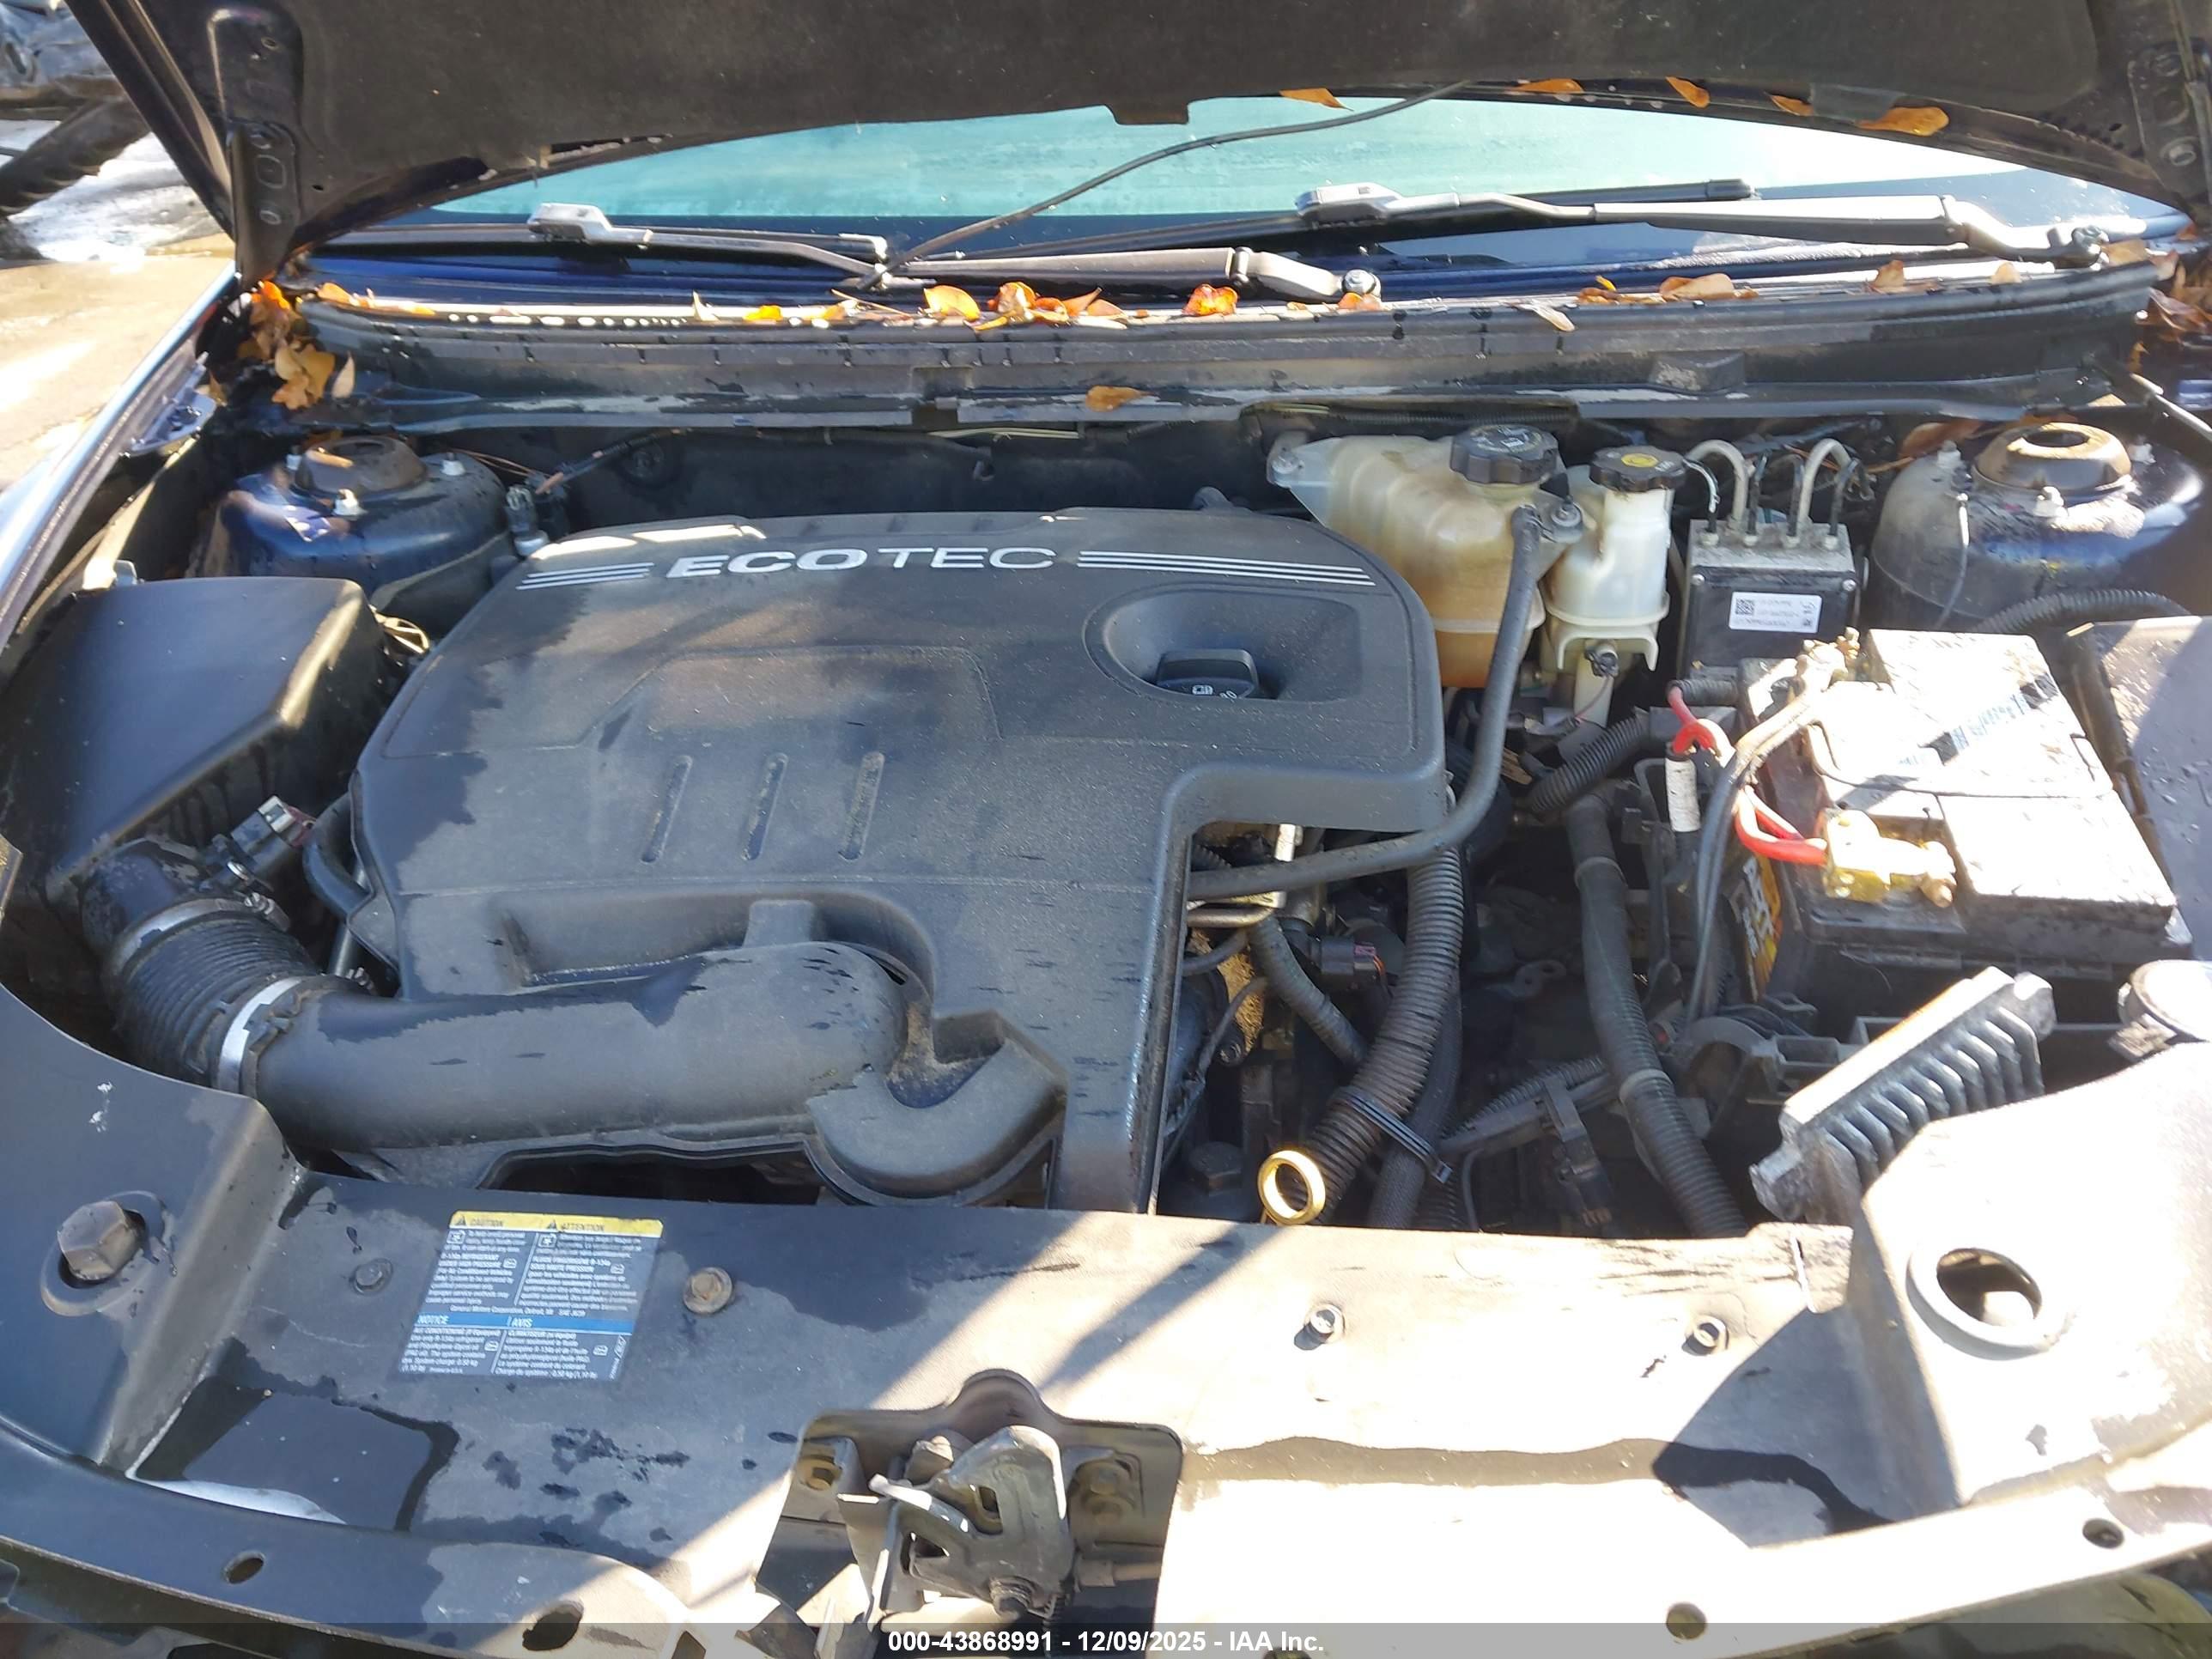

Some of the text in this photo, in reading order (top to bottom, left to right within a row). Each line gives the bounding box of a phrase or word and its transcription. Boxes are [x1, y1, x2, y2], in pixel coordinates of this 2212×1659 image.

[666, 547, 1056, 579] ECOTEC
[470, 1218, 504, 1226] CAUTION
[561, 1222, 605, 1231] ATTENTION
[416, 1315, 449, 1325] NOTICE
[510, 1317, 533, 1328] AVIS
